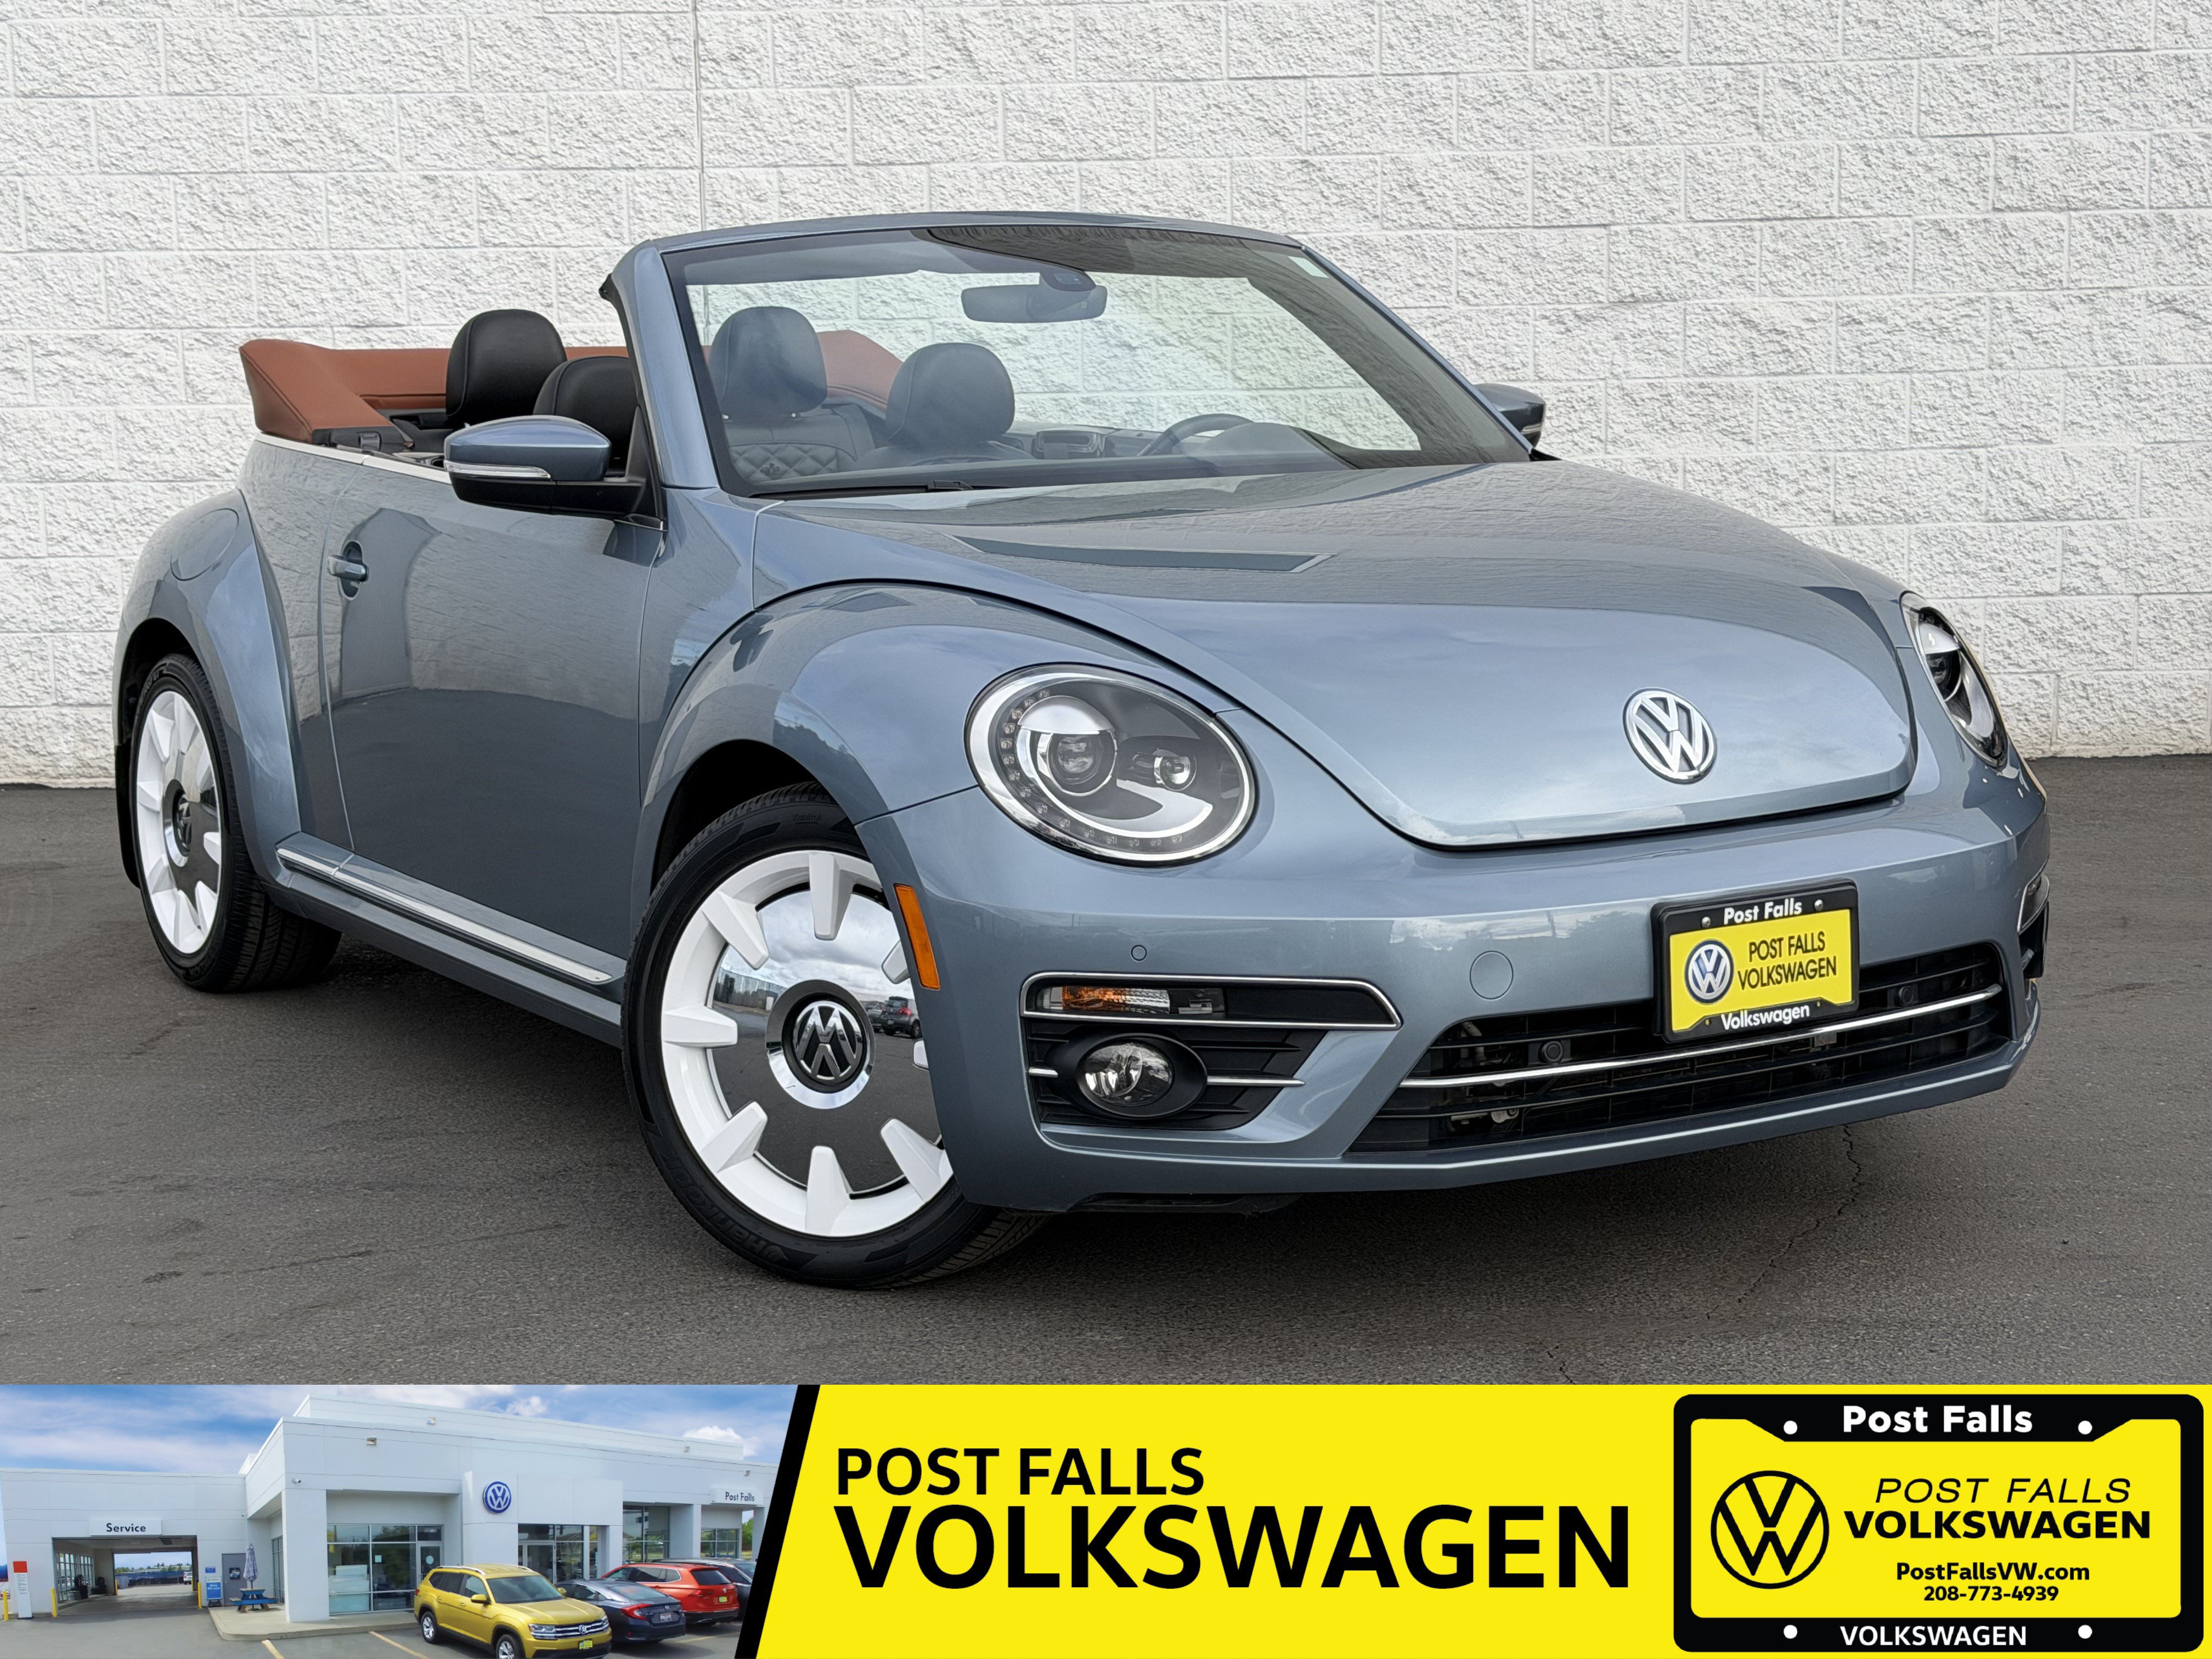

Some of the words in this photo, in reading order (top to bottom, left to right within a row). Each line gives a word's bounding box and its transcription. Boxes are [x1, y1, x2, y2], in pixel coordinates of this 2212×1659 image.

[1624, 690, 1716, 781] VW
[1723, 905, 1759, 925] Post
[1764, 898, 1803, 918] Falls
[1748, 937, 1784, 962] POST
[1787, 930, 1826, 956] FALLS
[1686, 941, 1732, 1002] VW
[1737, 955, 1837, 991] VOLKSWAGEN
[1720, 1004, 1810, 1031] Volkswagen
